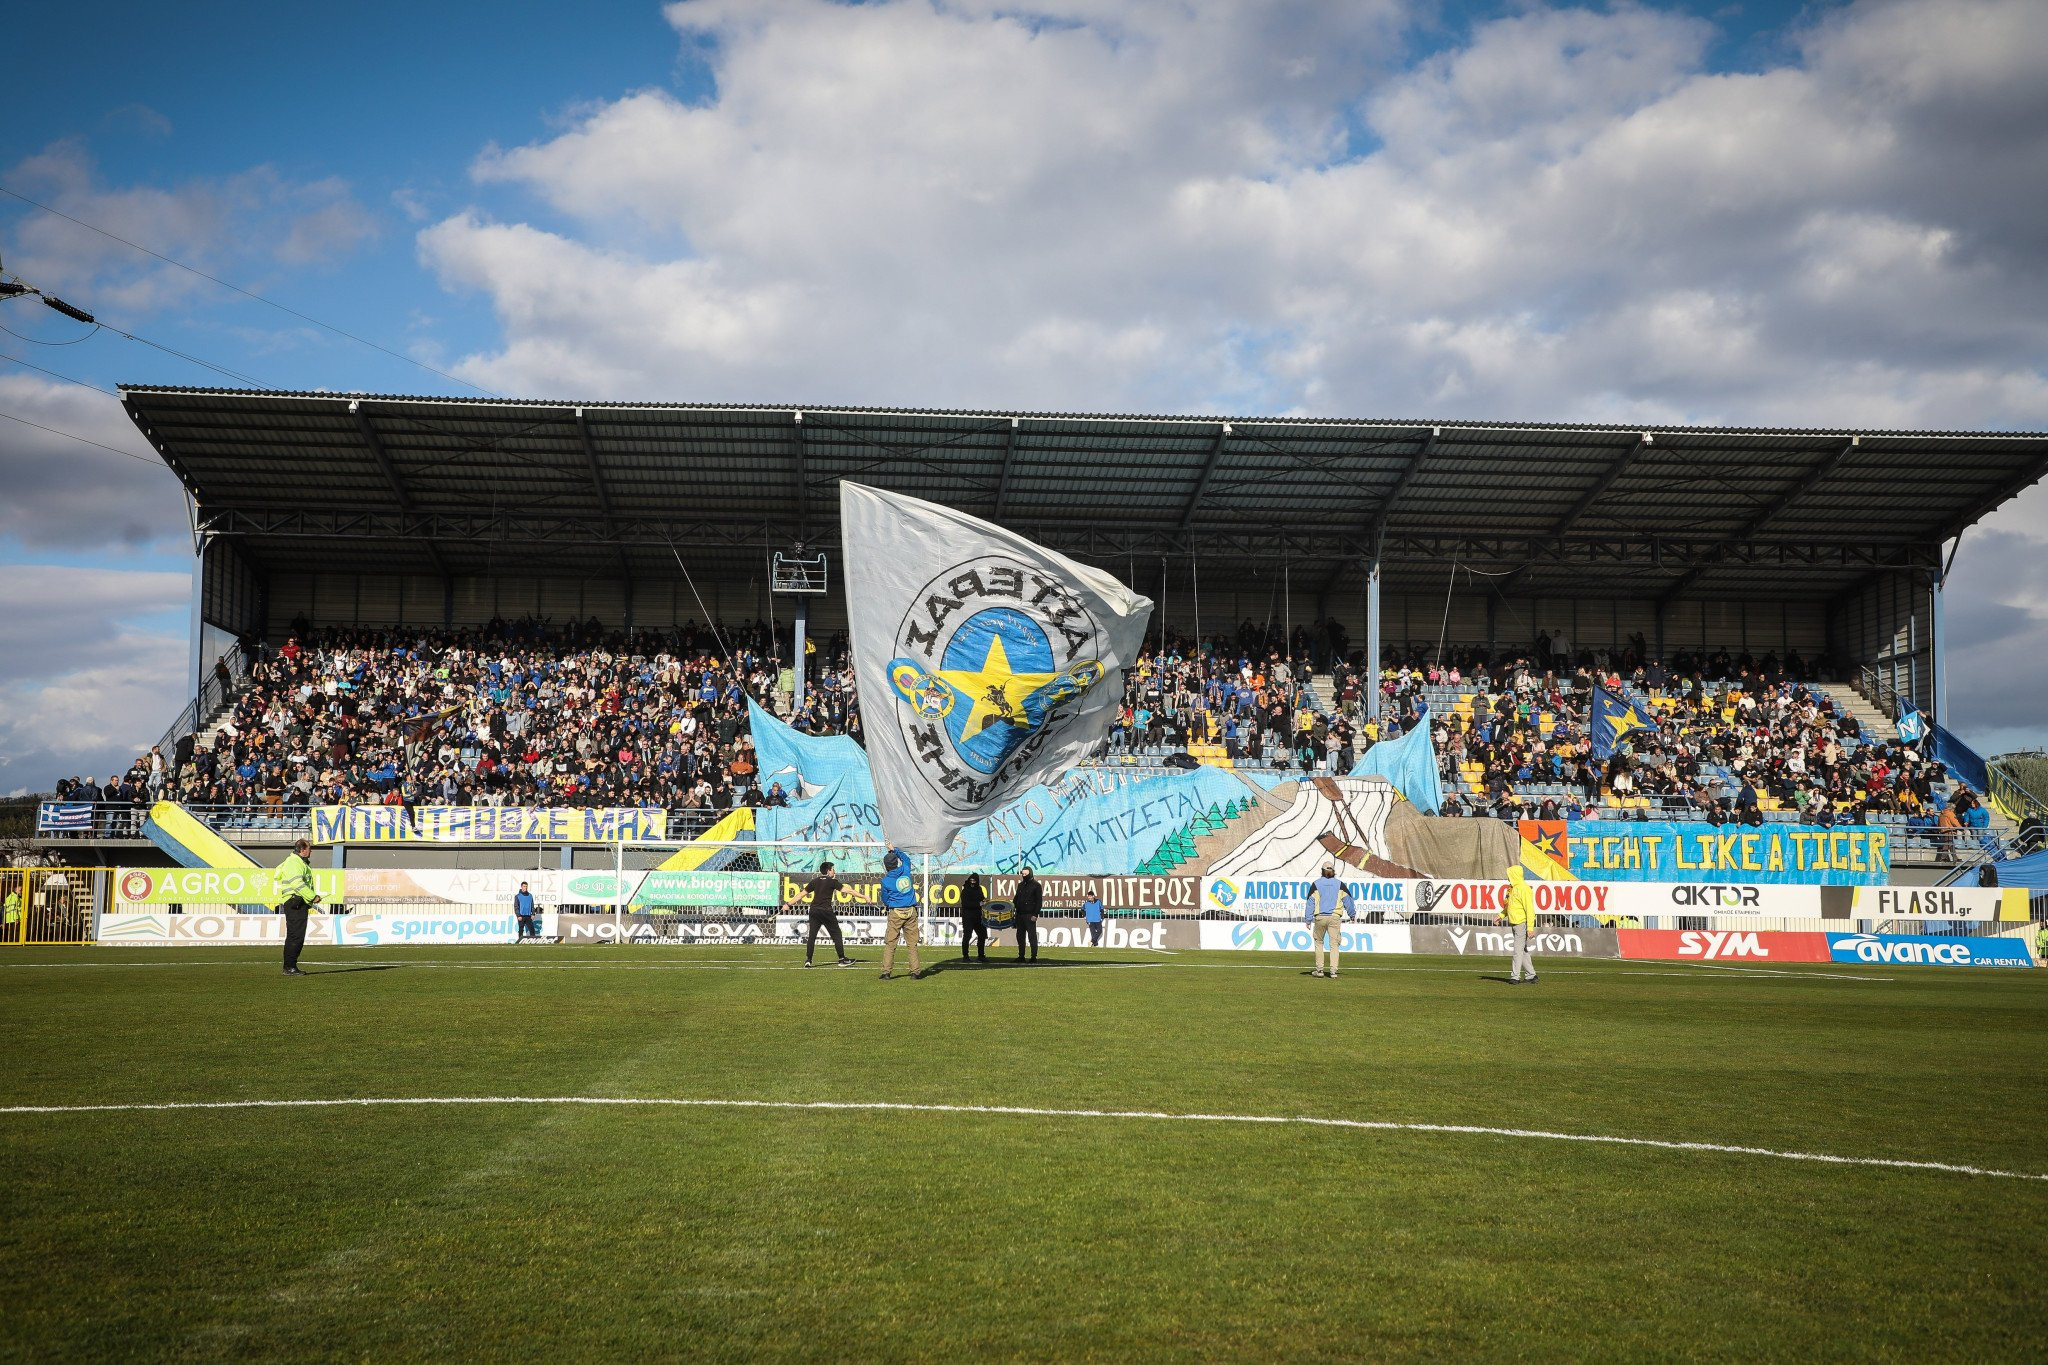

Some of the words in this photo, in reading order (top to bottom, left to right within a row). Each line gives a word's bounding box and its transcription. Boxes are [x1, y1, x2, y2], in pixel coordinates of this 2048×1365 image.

[584, 808, 664, 841] ΜΑΣ
[1088, 785, 1204, 845] ΧΤΙΖΕΤΑΙ
[1675, 832, 1762, 871] LIKE
[1768, 833, 1785, 872] A
[1789, 831, 1889, 874] TIGER
[158, 872, 245, 895] AGRO
[650, 876, 773, 894] www.biogreco.gr
[1102, 877, 1196, 907] ΠΙΤΕΡΟΣ
[1243, 902, 1288, 910] ΜΕΤΑΦΟΡΕΣ
[1450, 883, 1609, 912] ΟΙΚΟΟΜΟΥ
[1878, 890, 1972, 917] FLASH.gr
[570, 923, 656, 938] NOVA
[677, 922, 763, 938] NOVA
[1677, 931, 1769, 960] SYM
[1856, 940, 1971, 965] avance
[1974, 957, 1993, 966] CAR
[1994, 958, 2030, 967] RENTAL
